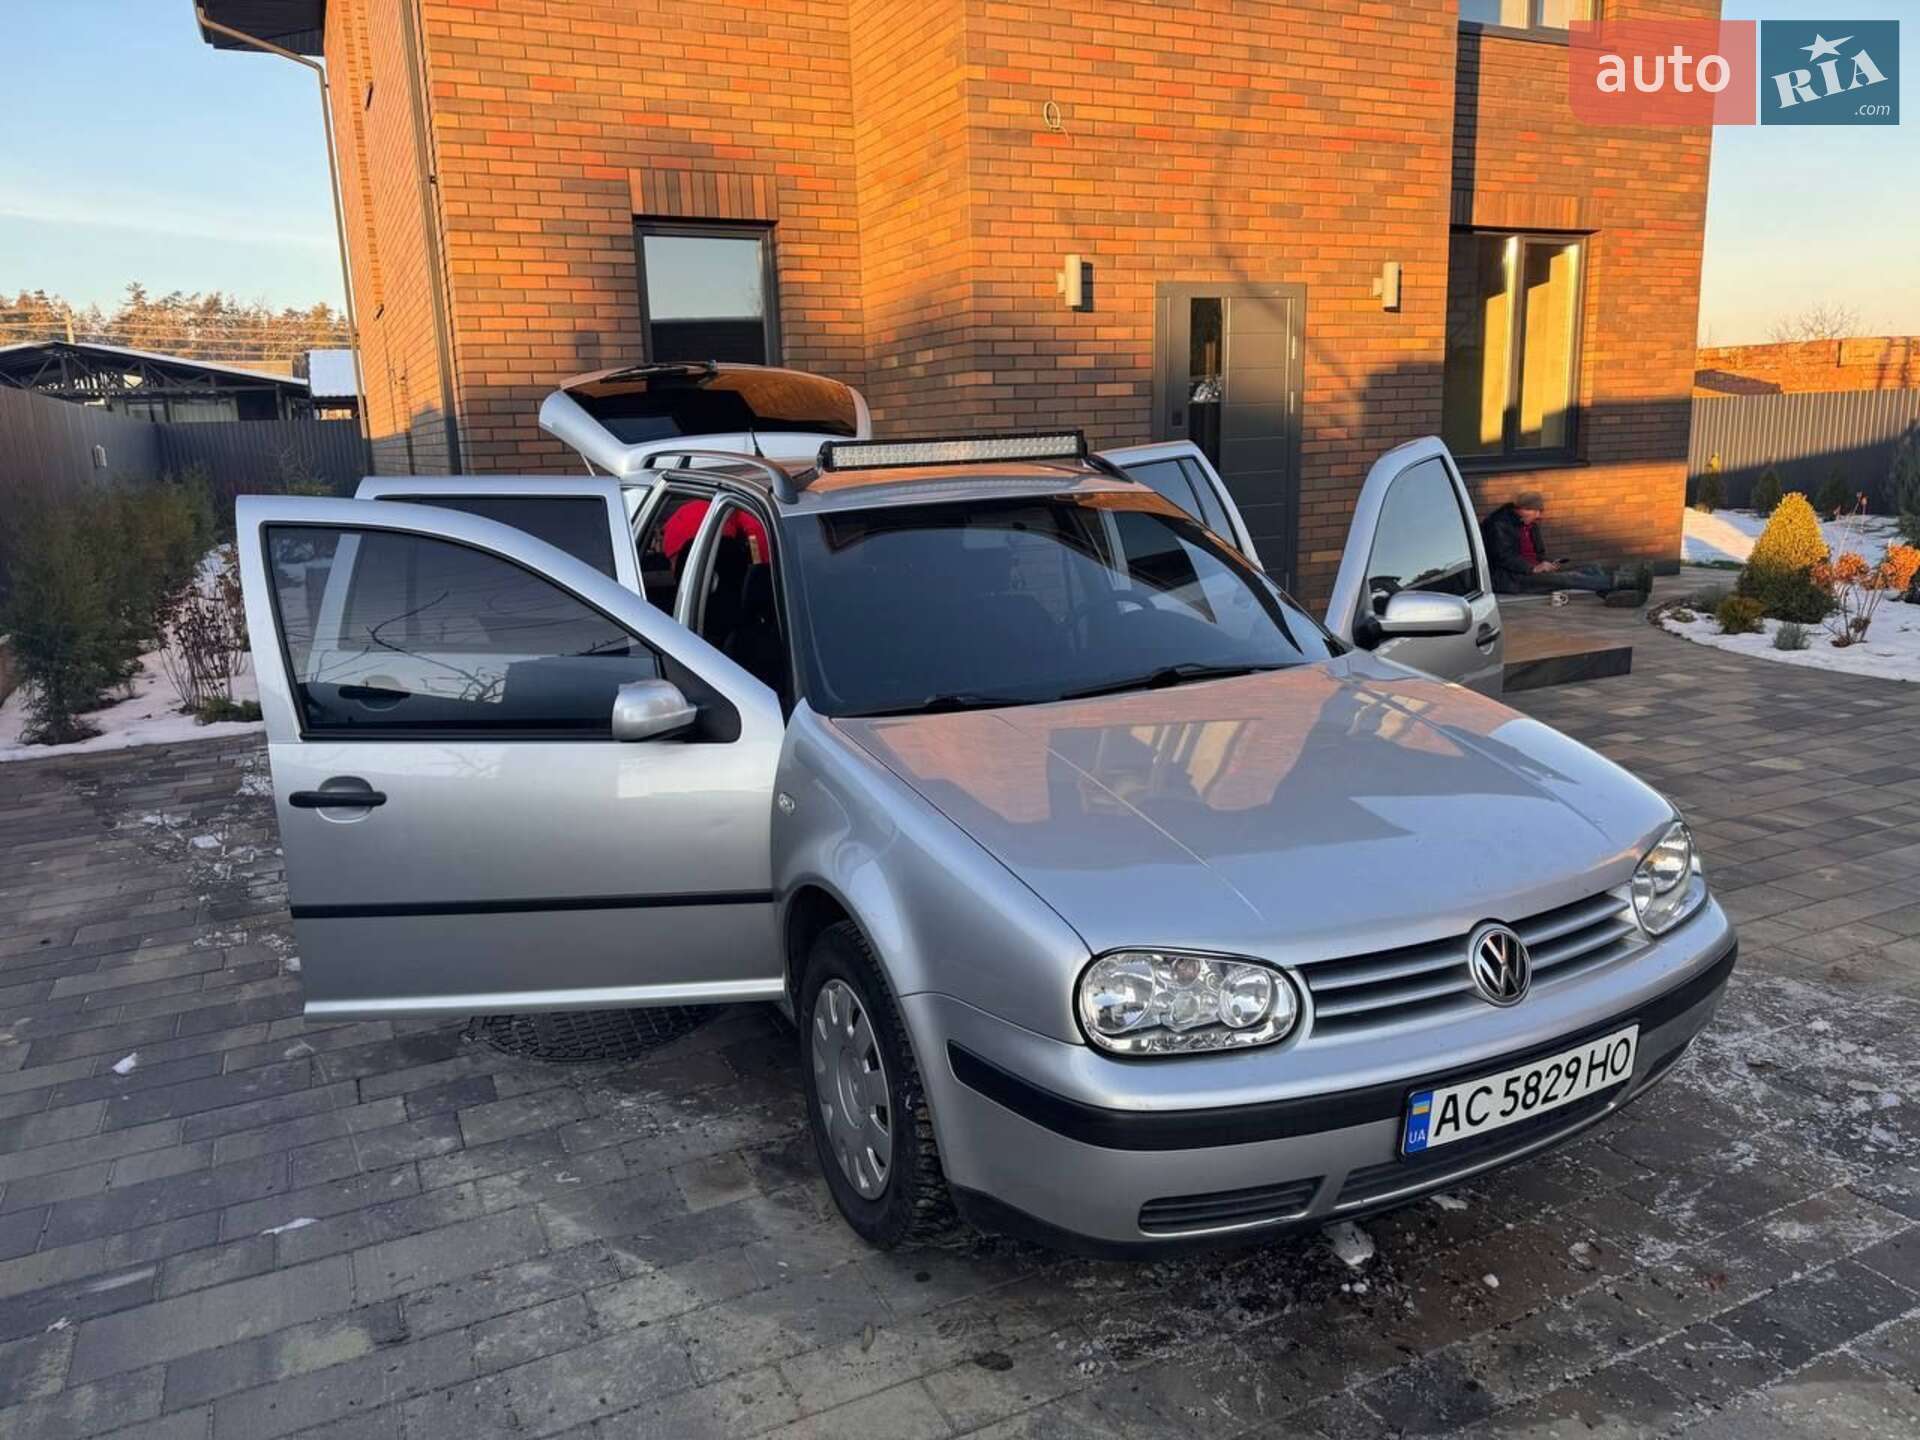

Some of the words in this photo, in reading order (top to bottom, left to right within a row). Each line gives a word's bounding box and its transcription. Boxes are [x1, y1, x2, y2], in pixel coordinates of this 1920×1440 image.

[1434, 1086, 1492, 1137] AC
[1500, 1056, 1581, 1118] 5829
[1585, 1037, 1630, 1089] HO
[1408, 1129, 1426, 1144] UA
